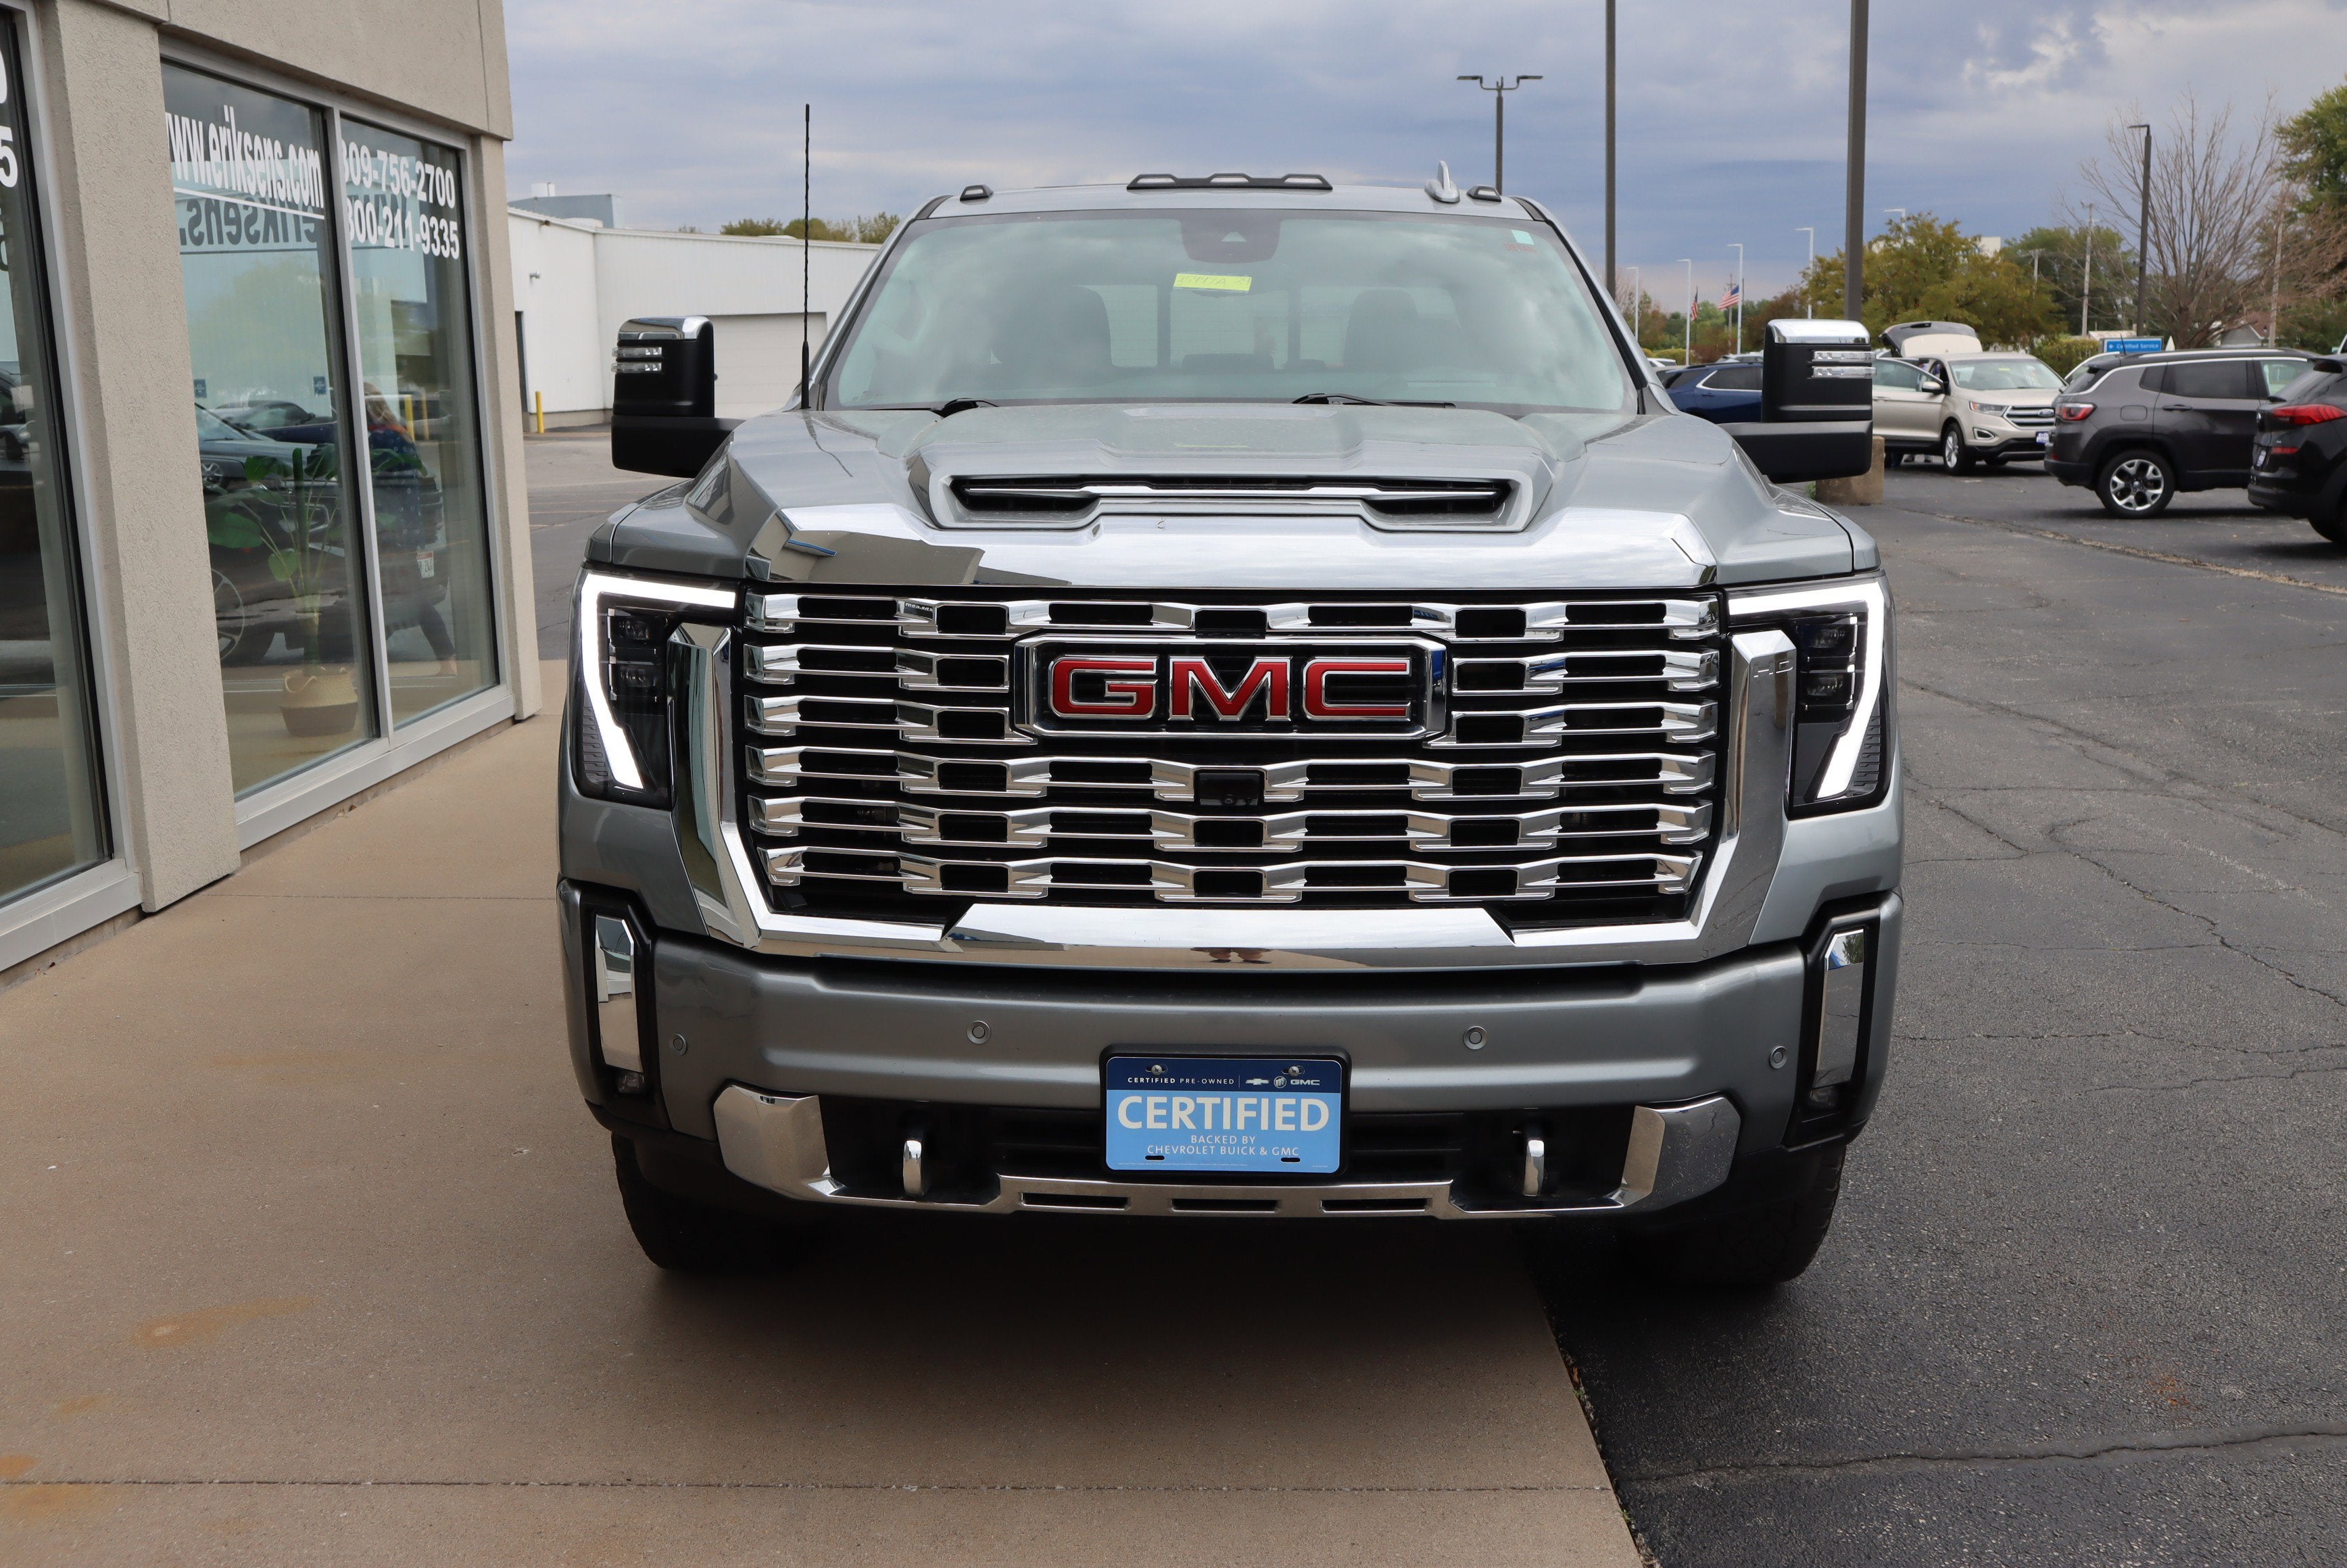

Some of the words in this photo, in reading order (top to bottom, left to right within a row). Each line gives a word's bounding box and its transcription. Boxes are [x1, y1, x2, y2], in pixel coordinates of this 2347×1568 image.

[1050, 656, 1411, 722] GMC
[1117, 1096, 1330, 1131] CERTIFIED
[1191, 1135, 1237, 1144] BACKED
[1147, 1146, 1215, 1154] CHEVROLET
[1220, 1146, 1255, 1155] BUICK
[1260, 1147, 1267, 1155] &
[1272, 1147, 1299, 1156] GMC
